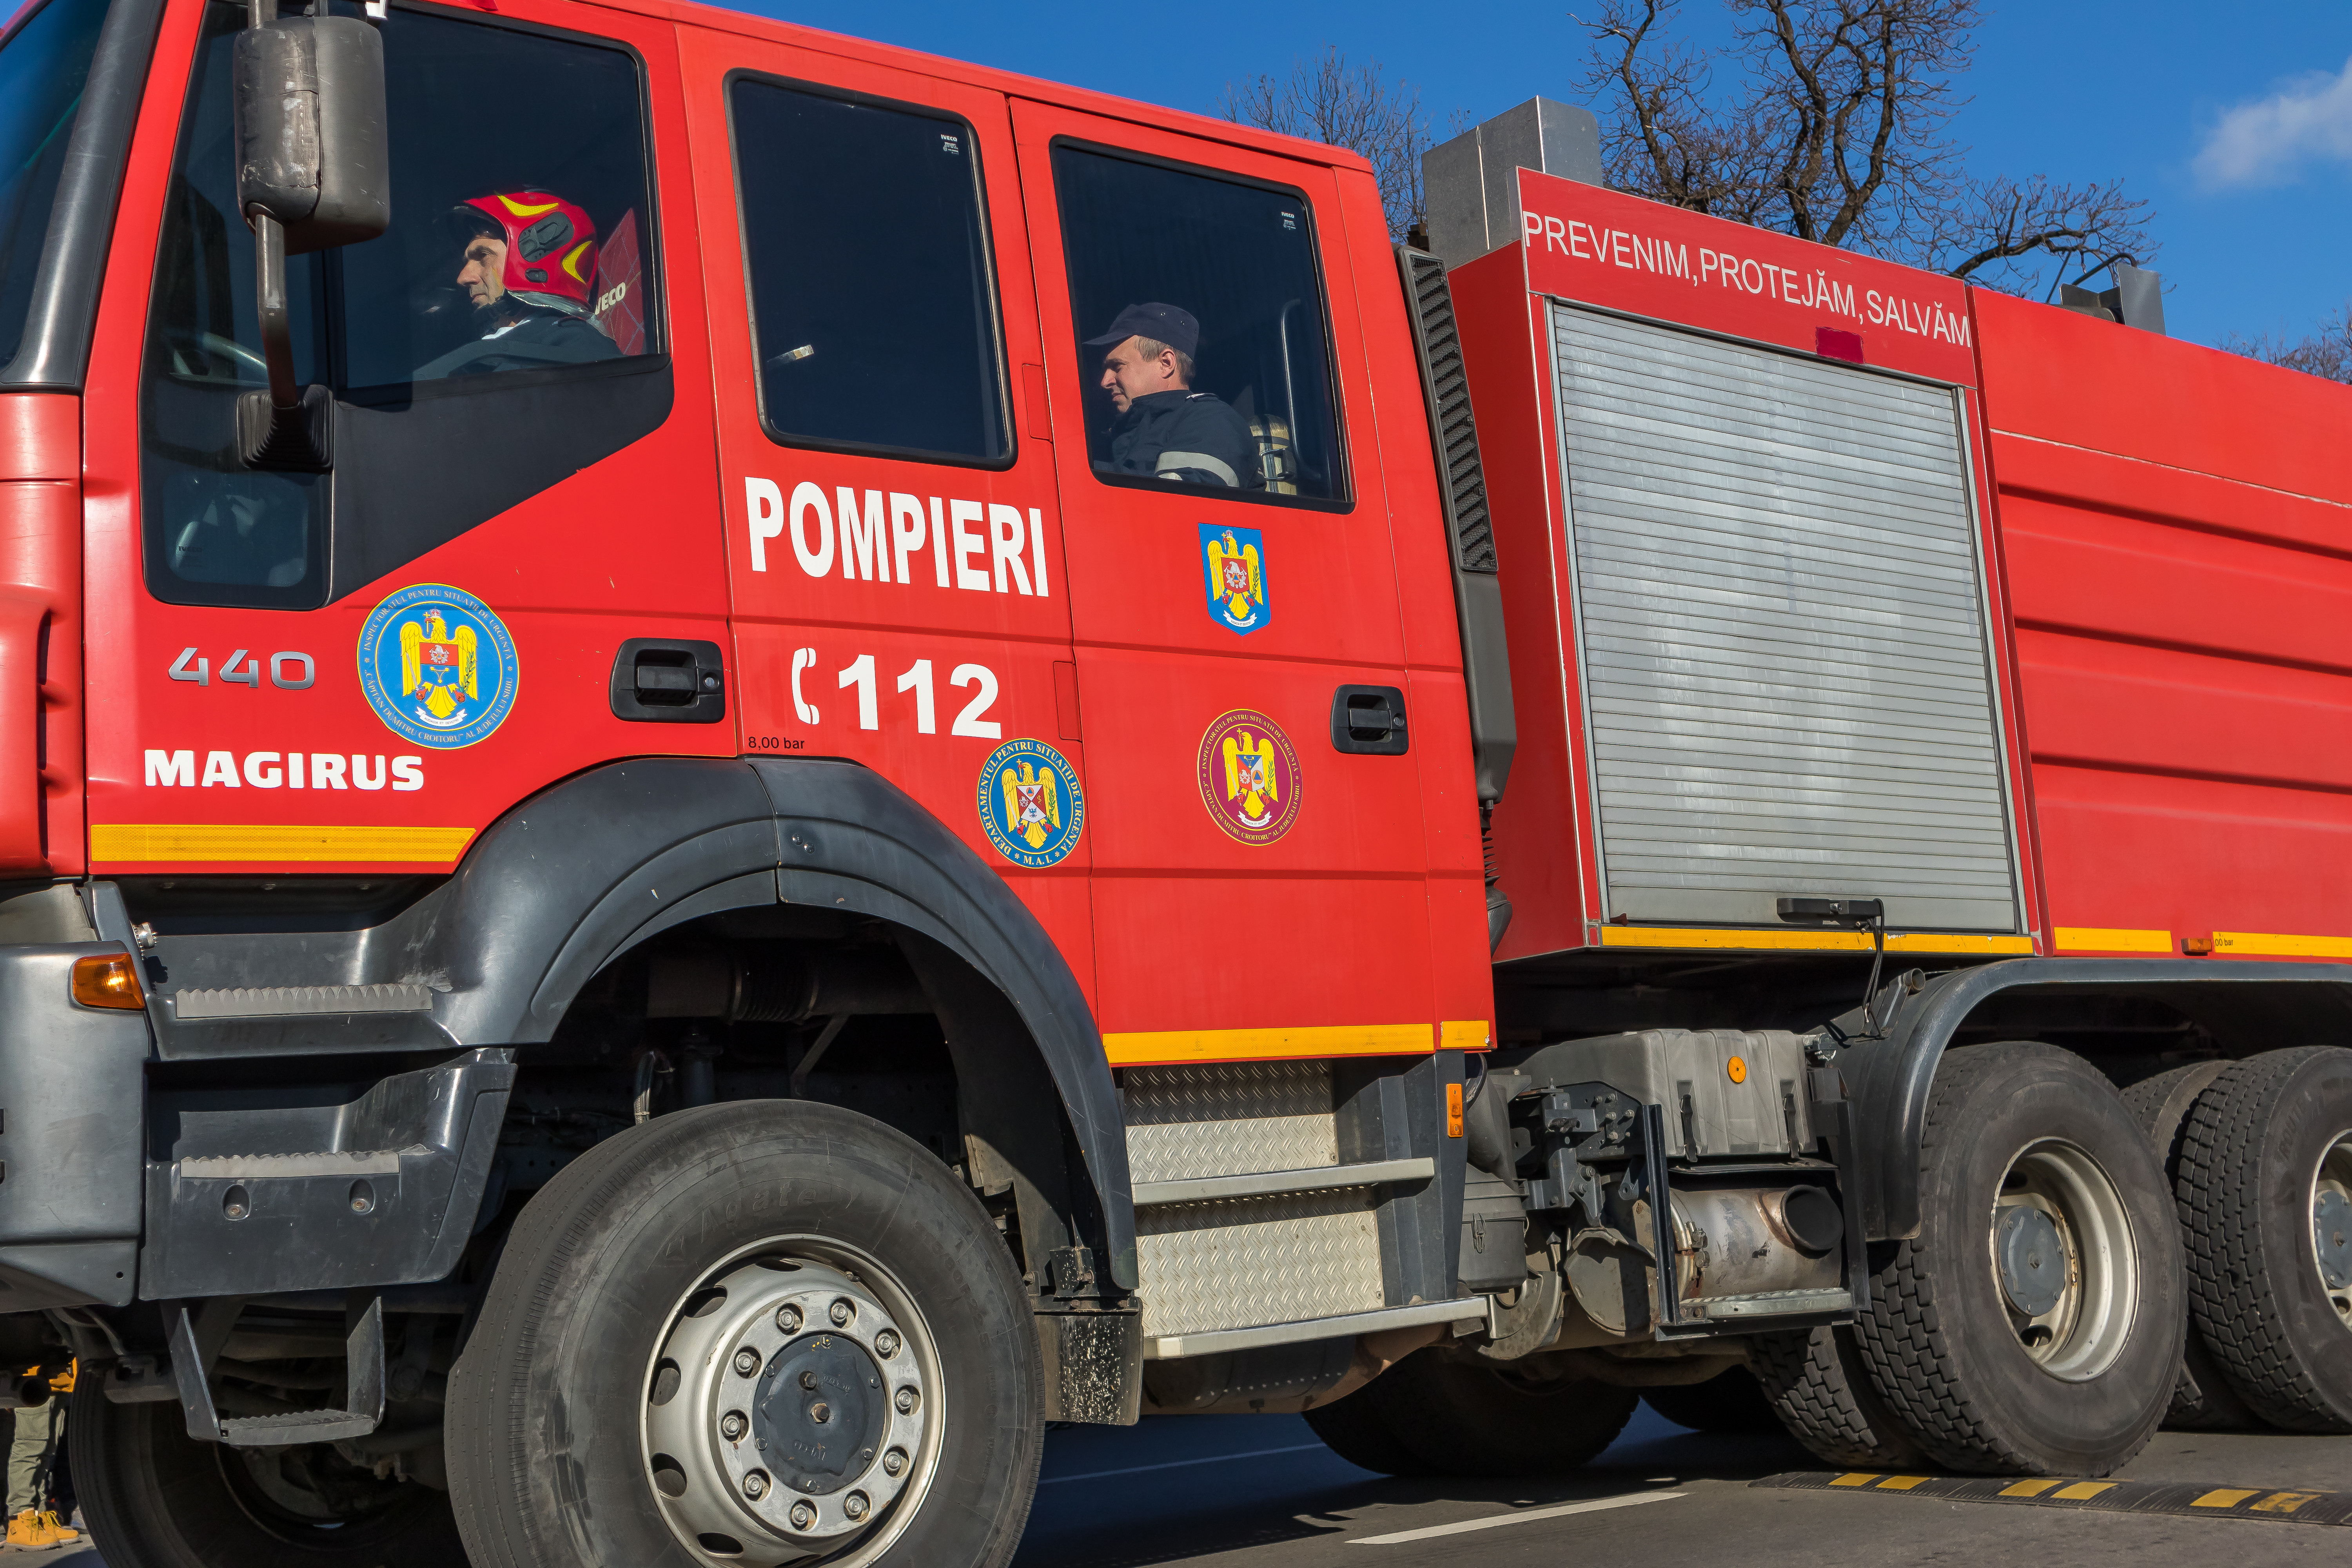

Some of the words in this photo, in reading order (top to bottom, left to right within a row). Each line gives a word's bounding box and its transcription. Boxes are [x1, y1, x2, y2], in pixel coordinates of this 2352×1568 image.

[595, 282, 626, 315] VECO
[745, 476, 1049, 598] POMPIERI
[363, 595, 408, 651] INSPECTORATUL
[408, 589, 441, 600] PENTRU
[478, 609, 490, 620] DE
[168, 647, 315, 690] 440
[383, 707, 418, 736] DUMITRU
[466, 730, 476, 739] AL
[503, 677, 513, 699] SIBIU
[838, 653, 1002, 740] 112
[748, 736, 779, 751] 8,00
[784, 737, 805, 749] bar
[1202, 720, 1227, 769] INSPECTORATUL
[1226, 714, 1249, 724] PENTRU
[1274, 730, 1283, 739] DE
[144, 749, 424, 791] MAGIRUS
[980, 760, 1012, 855] DEPARTAMENTUL
[996, 742, 1034, 761] PENTRU
[1070, 781, 1081, 798] DE
[1216, 812, 1241, 836] DUMITRU
[2224, 937, 2233, 946] bar
